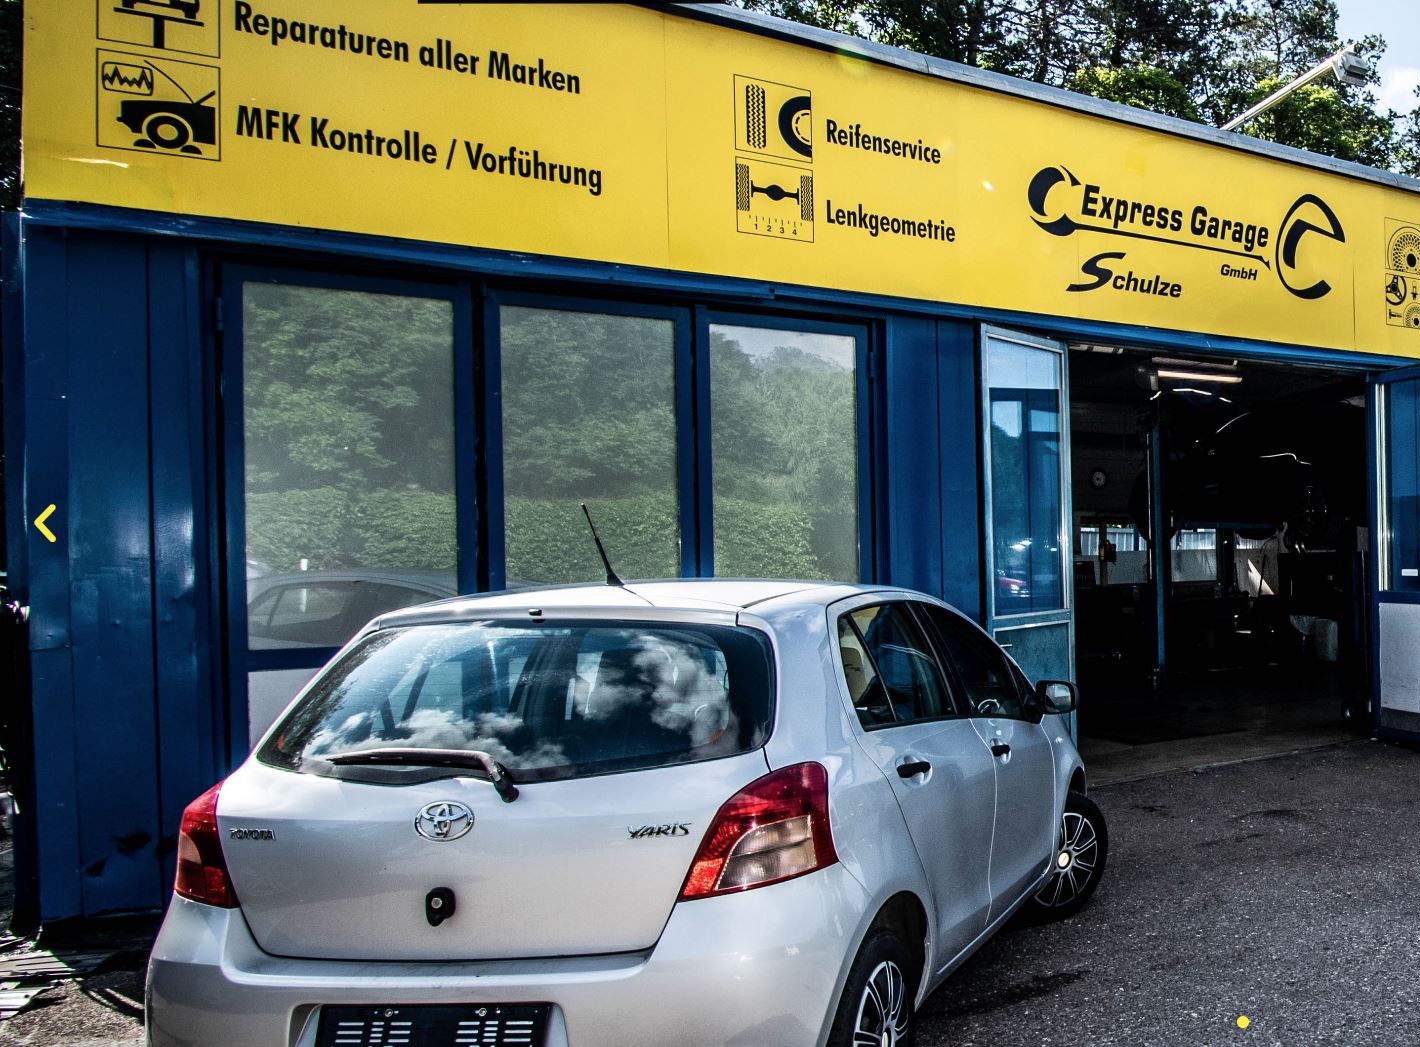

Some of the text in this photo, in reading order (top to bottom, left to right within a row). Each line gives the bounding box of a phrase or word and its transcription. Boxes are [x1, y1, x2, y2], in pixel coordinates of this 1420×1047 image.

[235, 1, 579, 94] Reparaturen aller Marken
[236, 105, 601, 196] MFK Kontrolle / Vorführung
[827, 119, 940, 163] Reifenservice
[767, 225, 772, 233] 2
[827, 200, 955, 242] Lenkgeometrie
[1081, 184, 1268, 252] Express Garage
[1066, 252, 1181, 297] Schulze
[1220, 264, 1258, 281] GmbH
[229, 828, 276, 841] TOYOTA
[627, 822, 692, 839] YARIS
